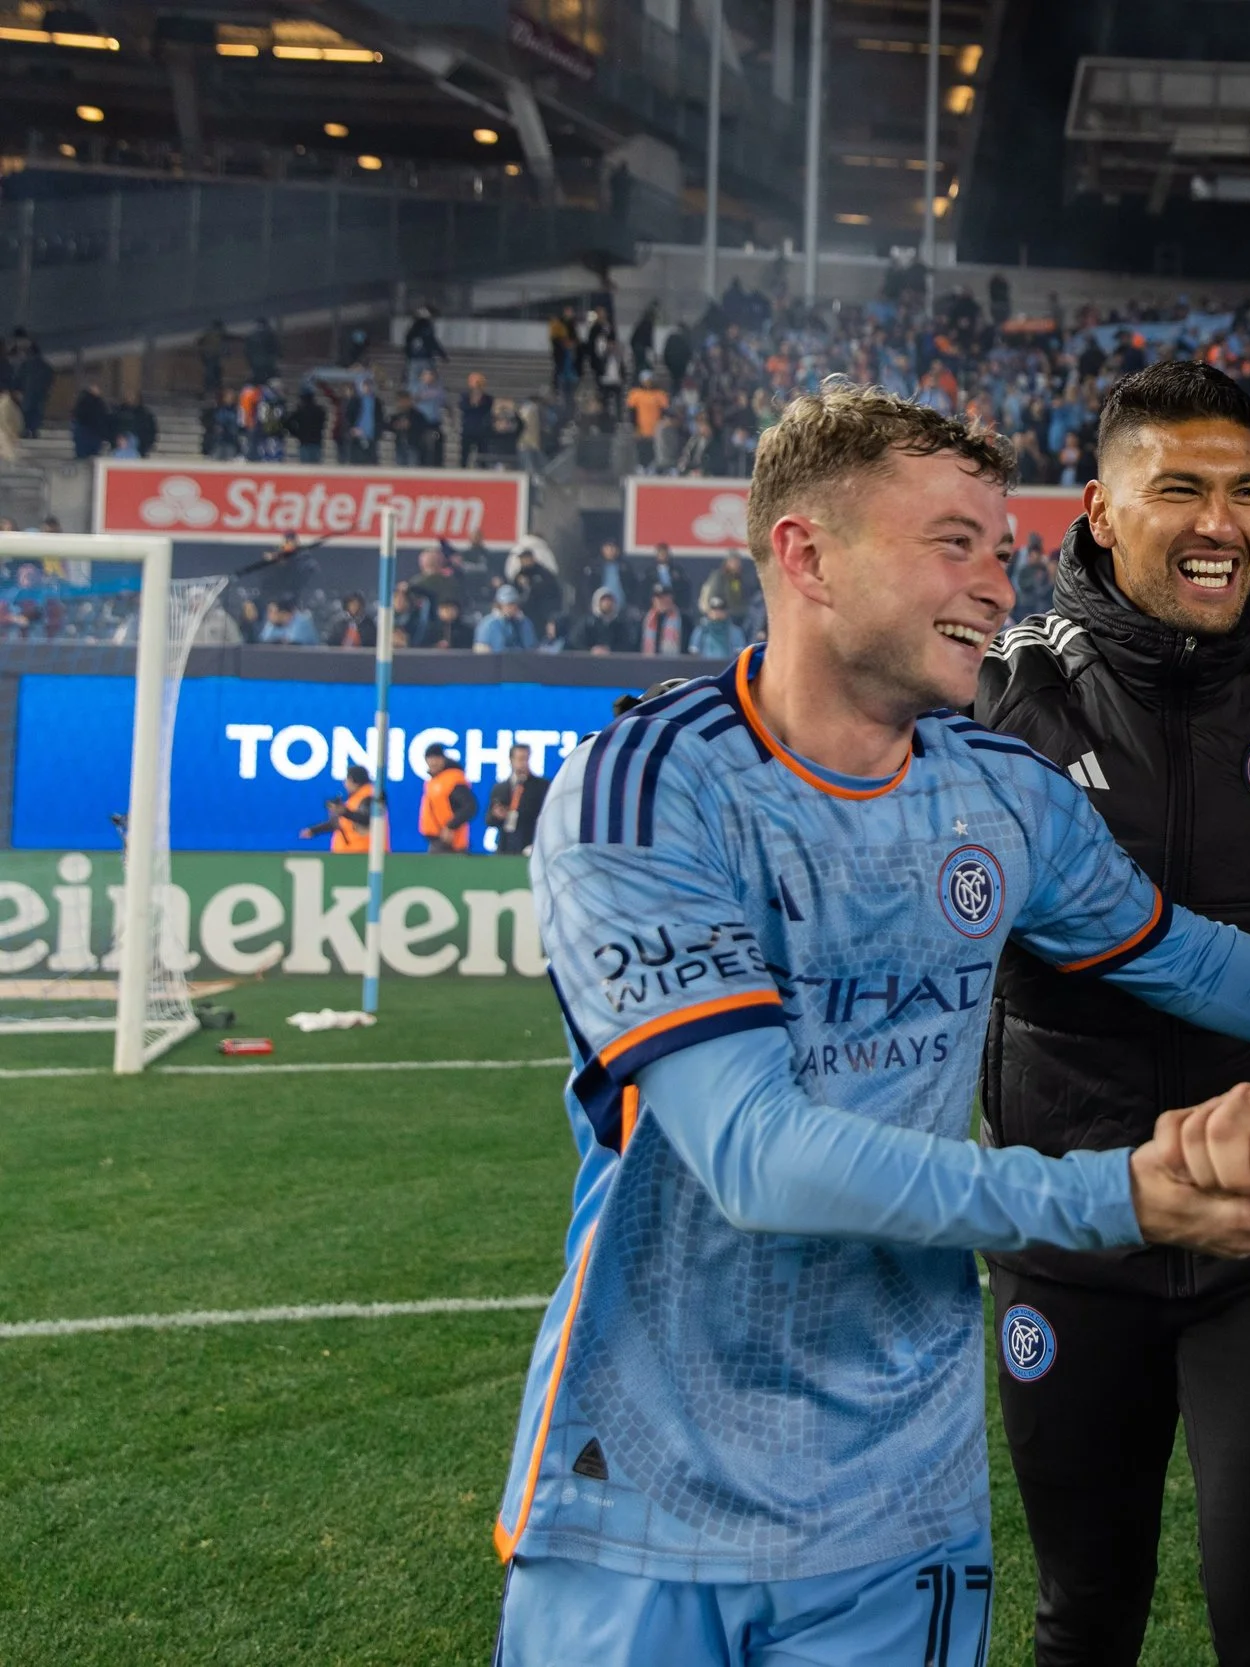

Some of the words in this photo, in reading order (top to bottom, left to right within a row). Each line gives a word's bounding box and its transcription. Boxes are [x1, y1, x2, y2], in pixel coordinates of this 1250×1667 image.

[226, 724, 580, 783] TONIGHT'
[0, 853, 556, 977] eineken
[606, 946, 768, 1013] WIPES
